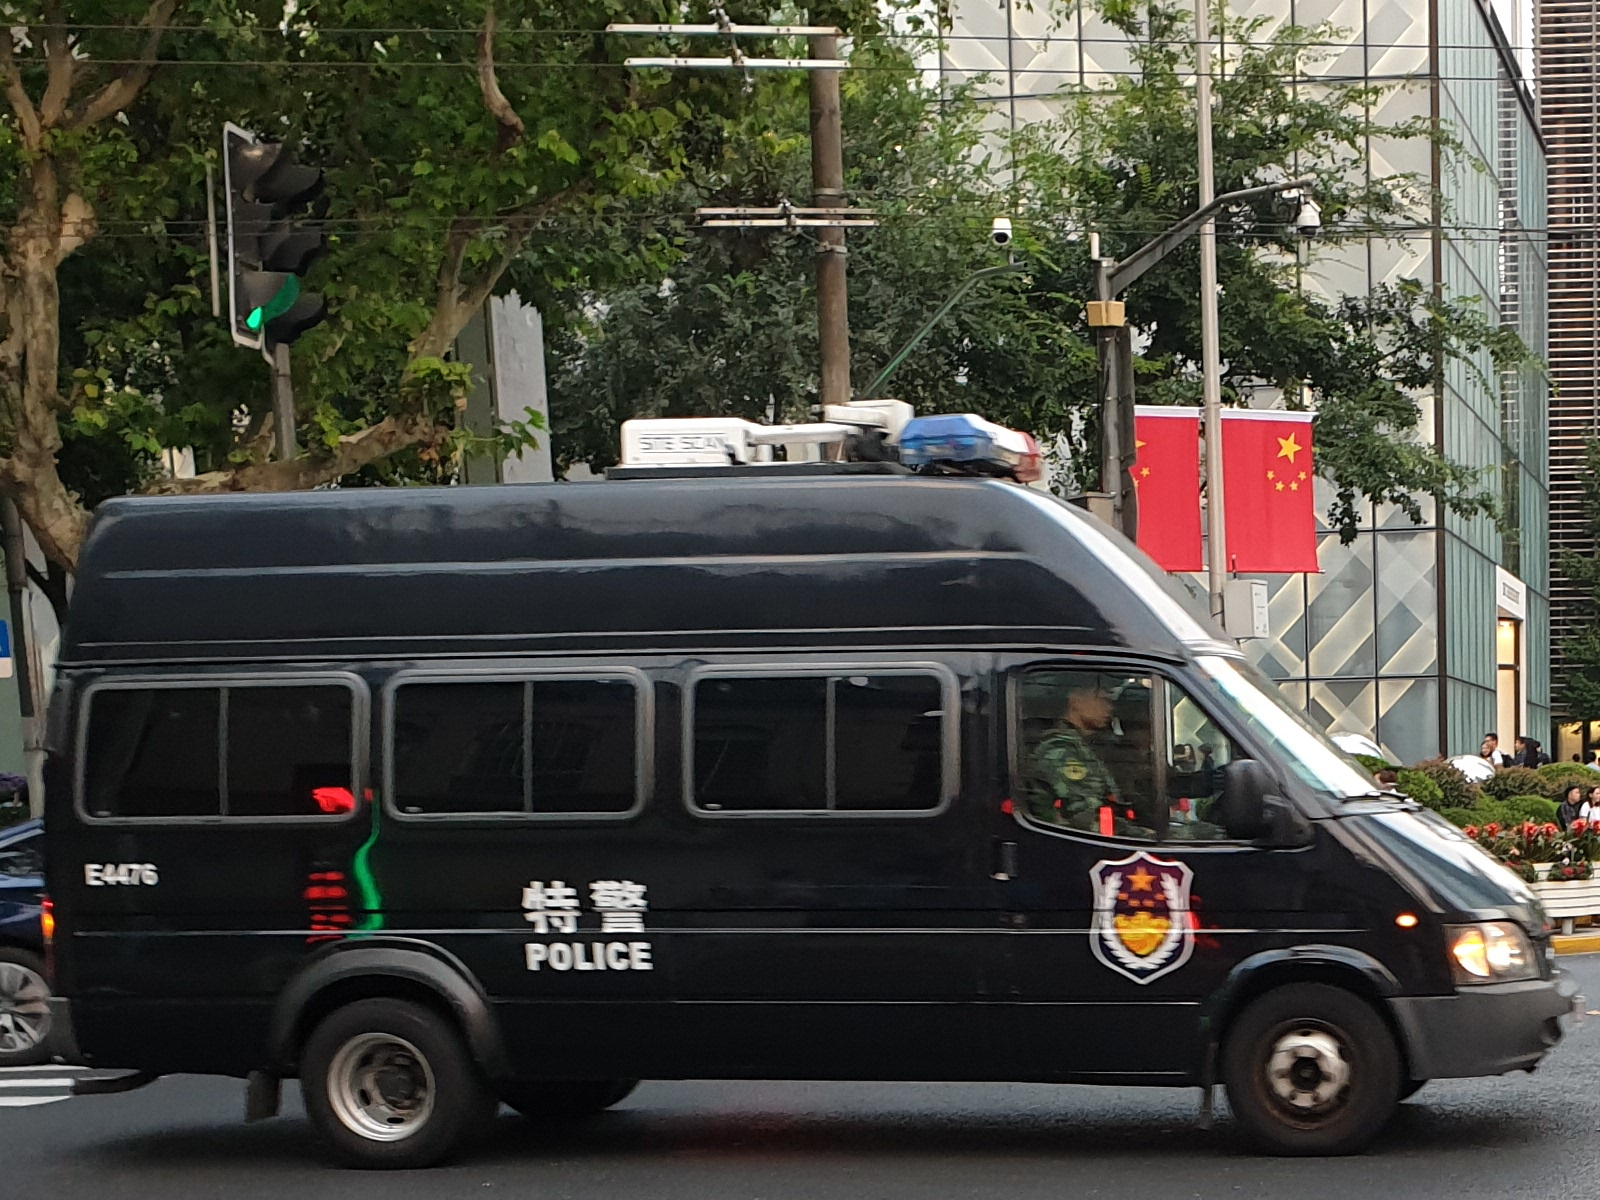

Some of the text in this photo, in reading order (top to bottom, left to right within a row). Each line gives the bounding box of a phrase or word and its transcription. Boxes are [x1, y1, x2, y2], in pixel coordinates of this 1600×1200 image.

[84, 863, 159, 886] E4476
[521, 880, 649, 934] 特警
[525, 941, 653, 971] POLICE
